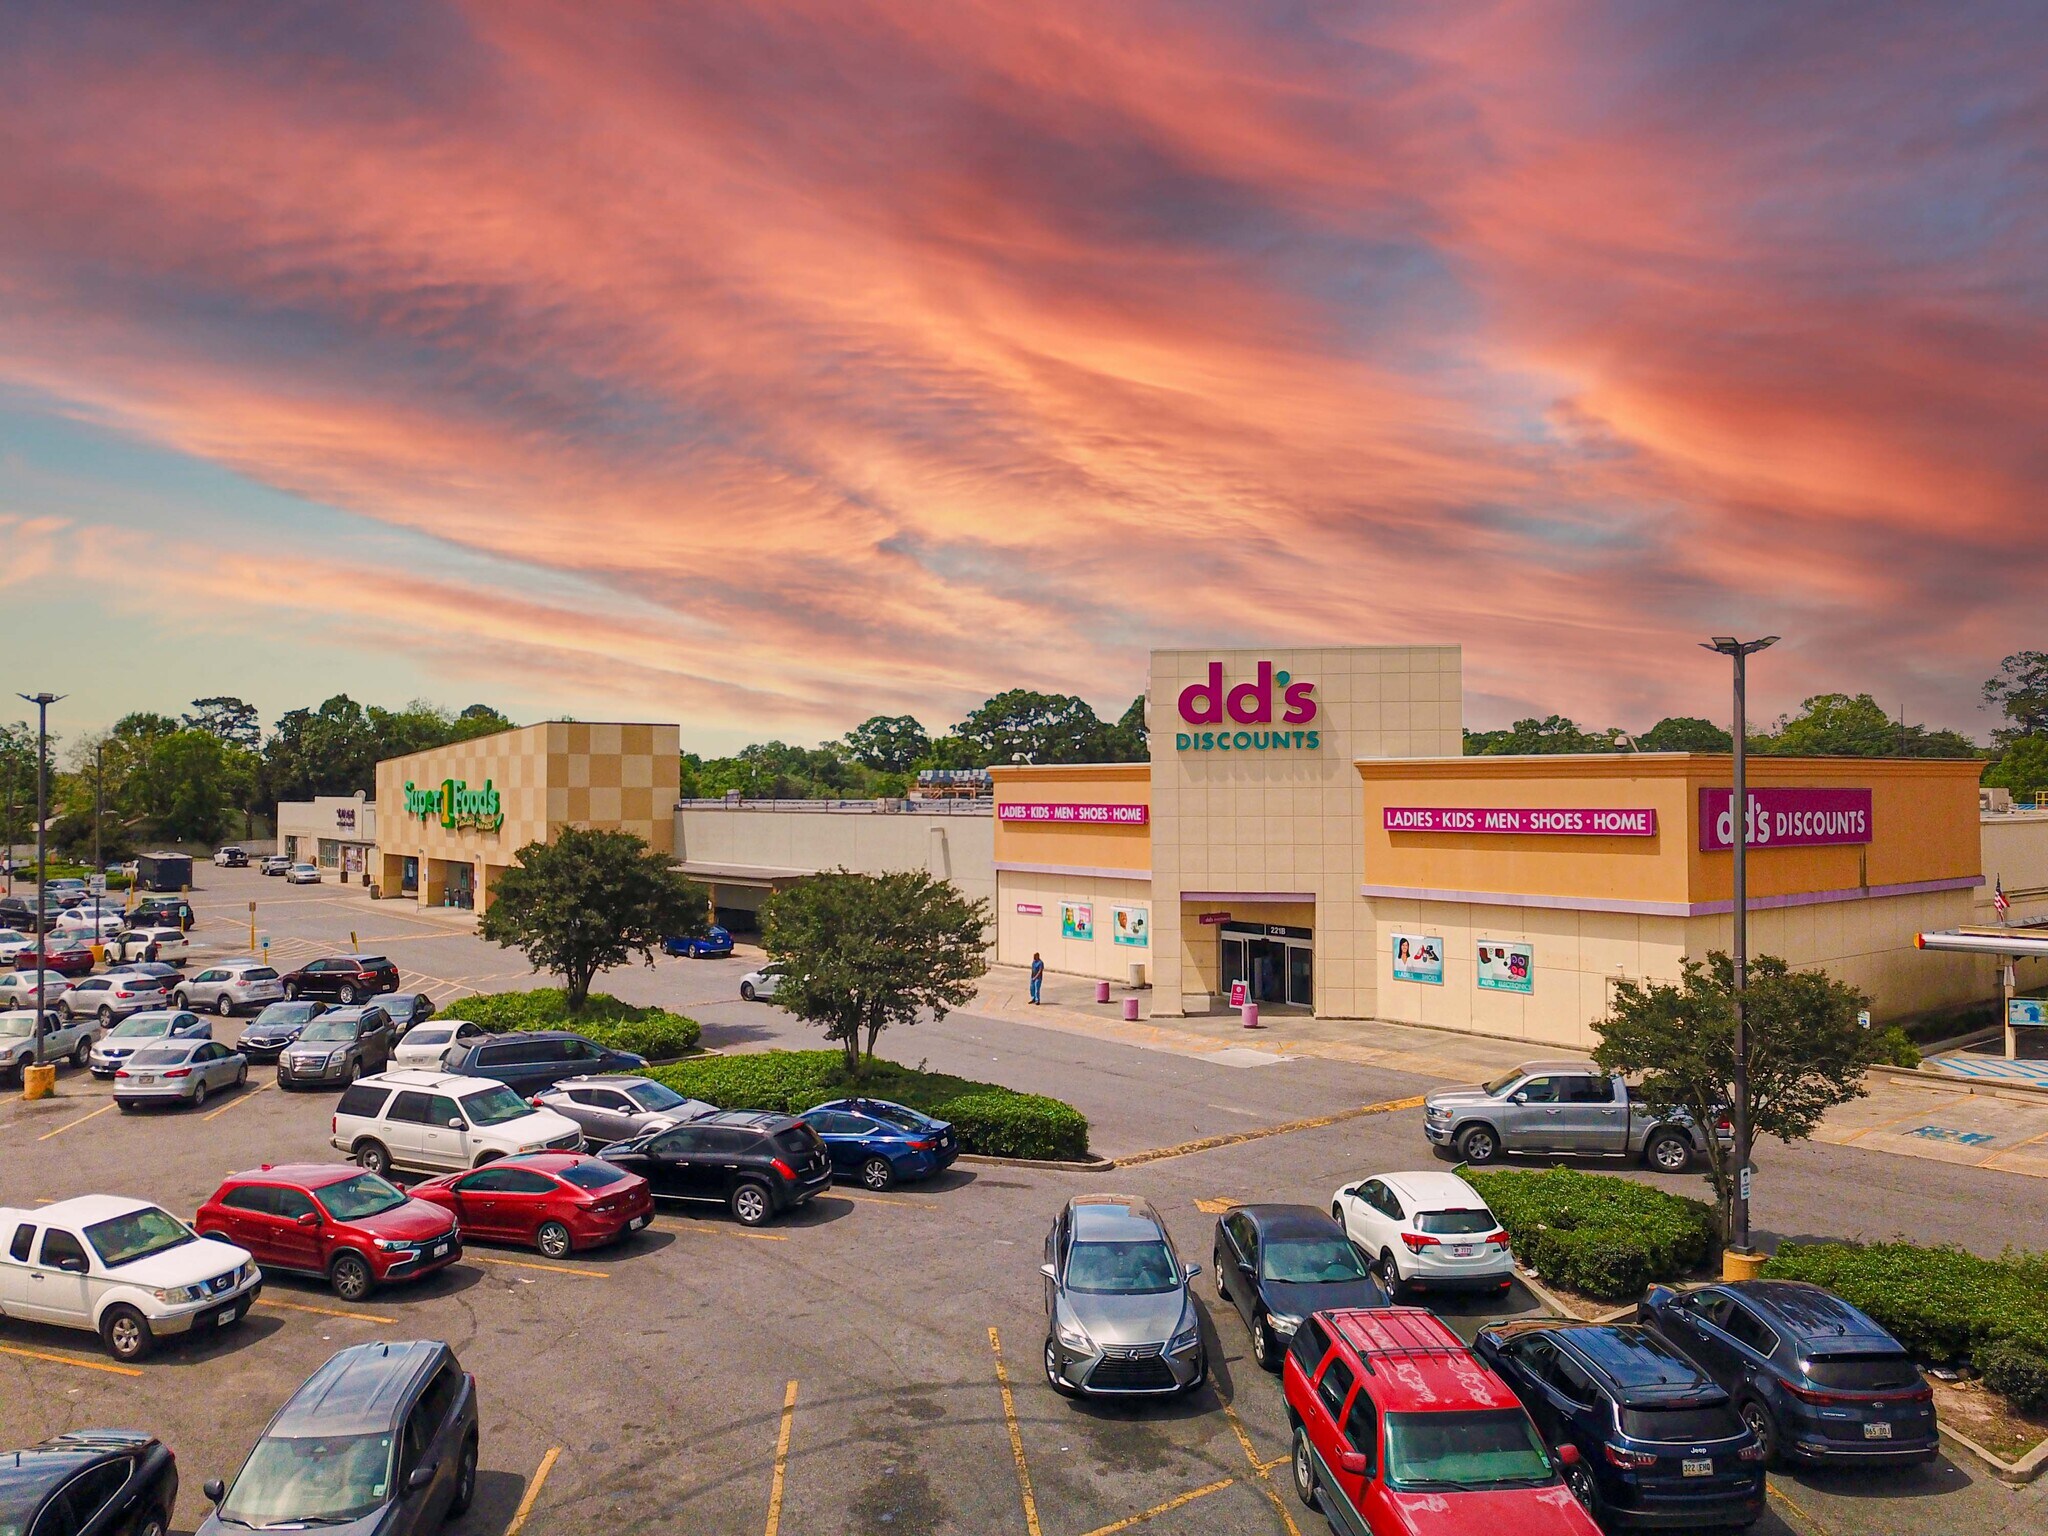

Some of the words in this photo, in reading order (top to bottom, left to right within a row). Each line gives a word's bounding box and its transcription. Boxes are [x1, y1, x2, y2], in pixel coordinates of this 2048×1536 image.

[1177, 660, 1318, 725] dd's
[1175, 730, 1320, 751] DISCOUNTS
[403, 780, 444, 822] Super
[441, 779, 456, 829] 1
[454, 779, 500, 815] Foods
[999, 805, 1026, 818] LADIES
[1030, 806, 1050, 819] KIDS
[1054, 806, 1074, 819] MEN
[1078, 807, 1108, 820] SHOES
[1113, 807, 1142, 821] HOME
[1387, 811, 1433, 828] LADIES
[1442, 812, 1475, 828] KIDS
[1485, 812, 1520, 829] MEN
[1529, 812, 1583, 830] SHOES
[1593, 813, 1647, 831] HOME
[1775, 809, 1866, 837] DISCOUNTS
[1690, 1447, 1707, 1455] Jeep
[1684, 1463, 1695, 1473] 322
